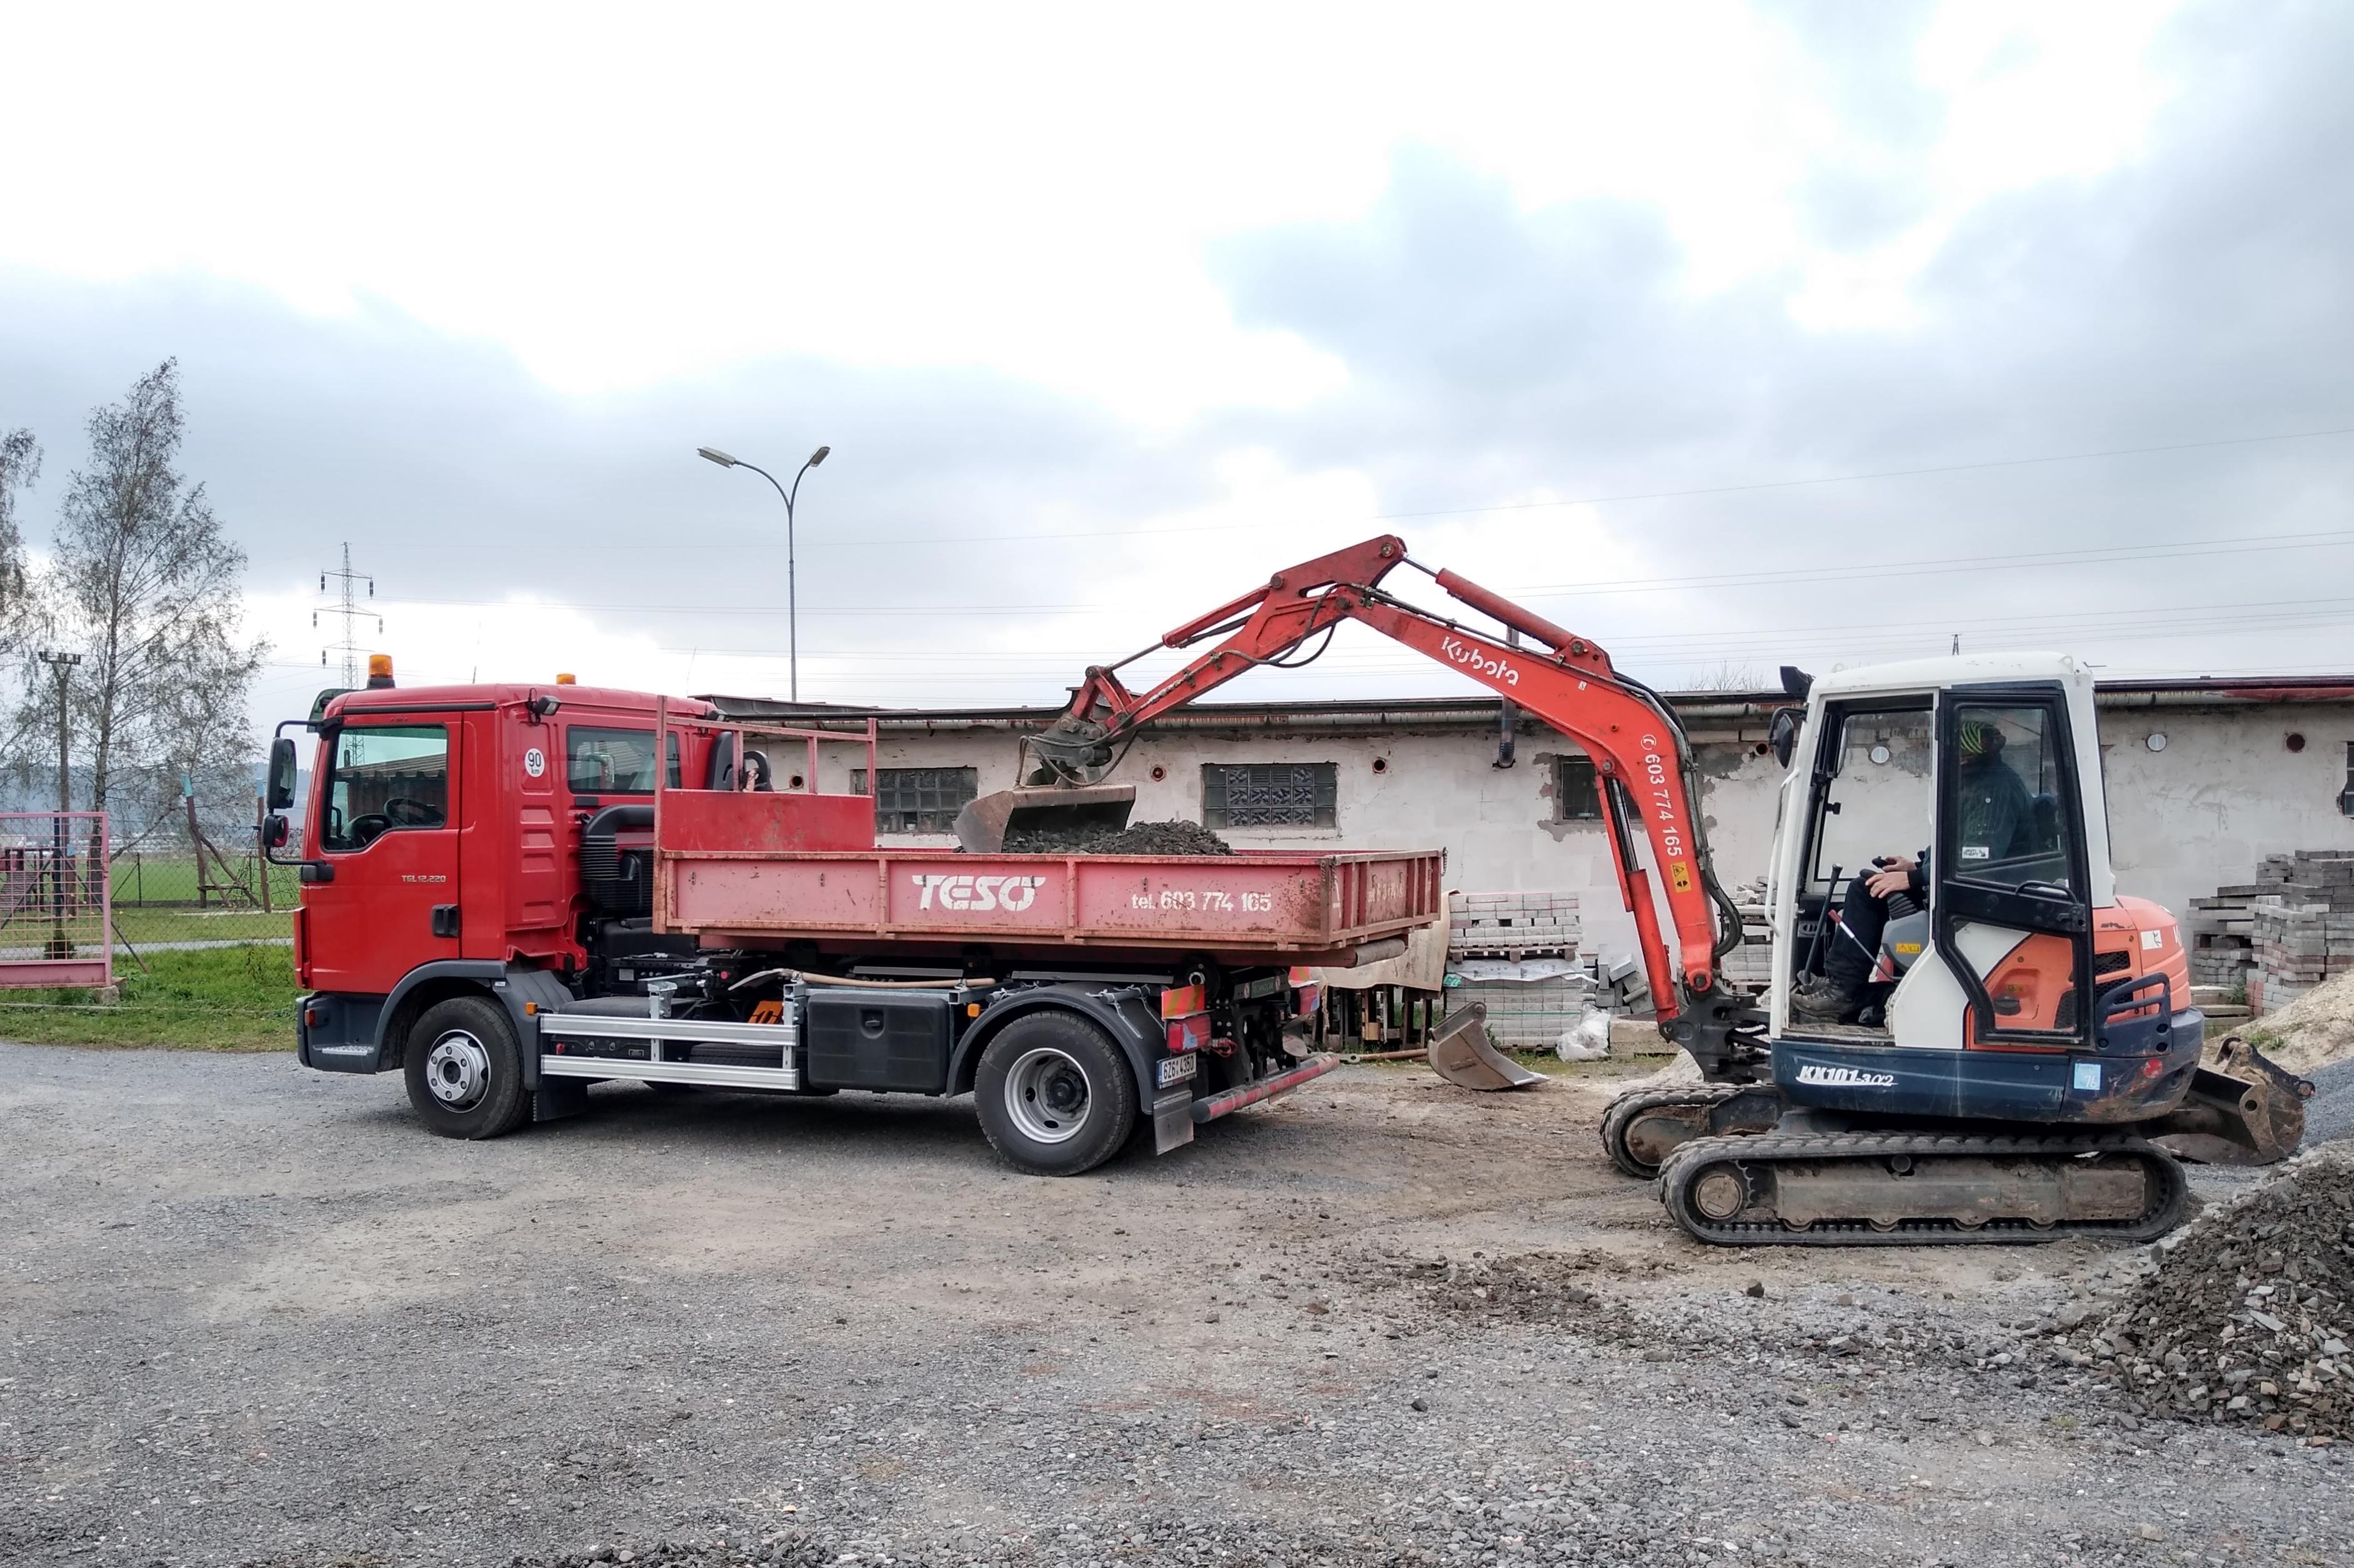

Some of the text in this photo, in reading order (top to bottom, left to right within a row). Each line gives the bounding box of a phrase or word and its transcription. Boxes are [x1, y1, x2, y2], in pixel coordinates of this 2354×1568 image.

[1441, 636, 1519, 686] Kubota
[528, 752, 541, 767] 90
[1645, 754, 1683, 856] 603 774 165
[912, 875, 1046, 911] TESO
[1132, 891, 1272, 912] tel. 603 774 165
